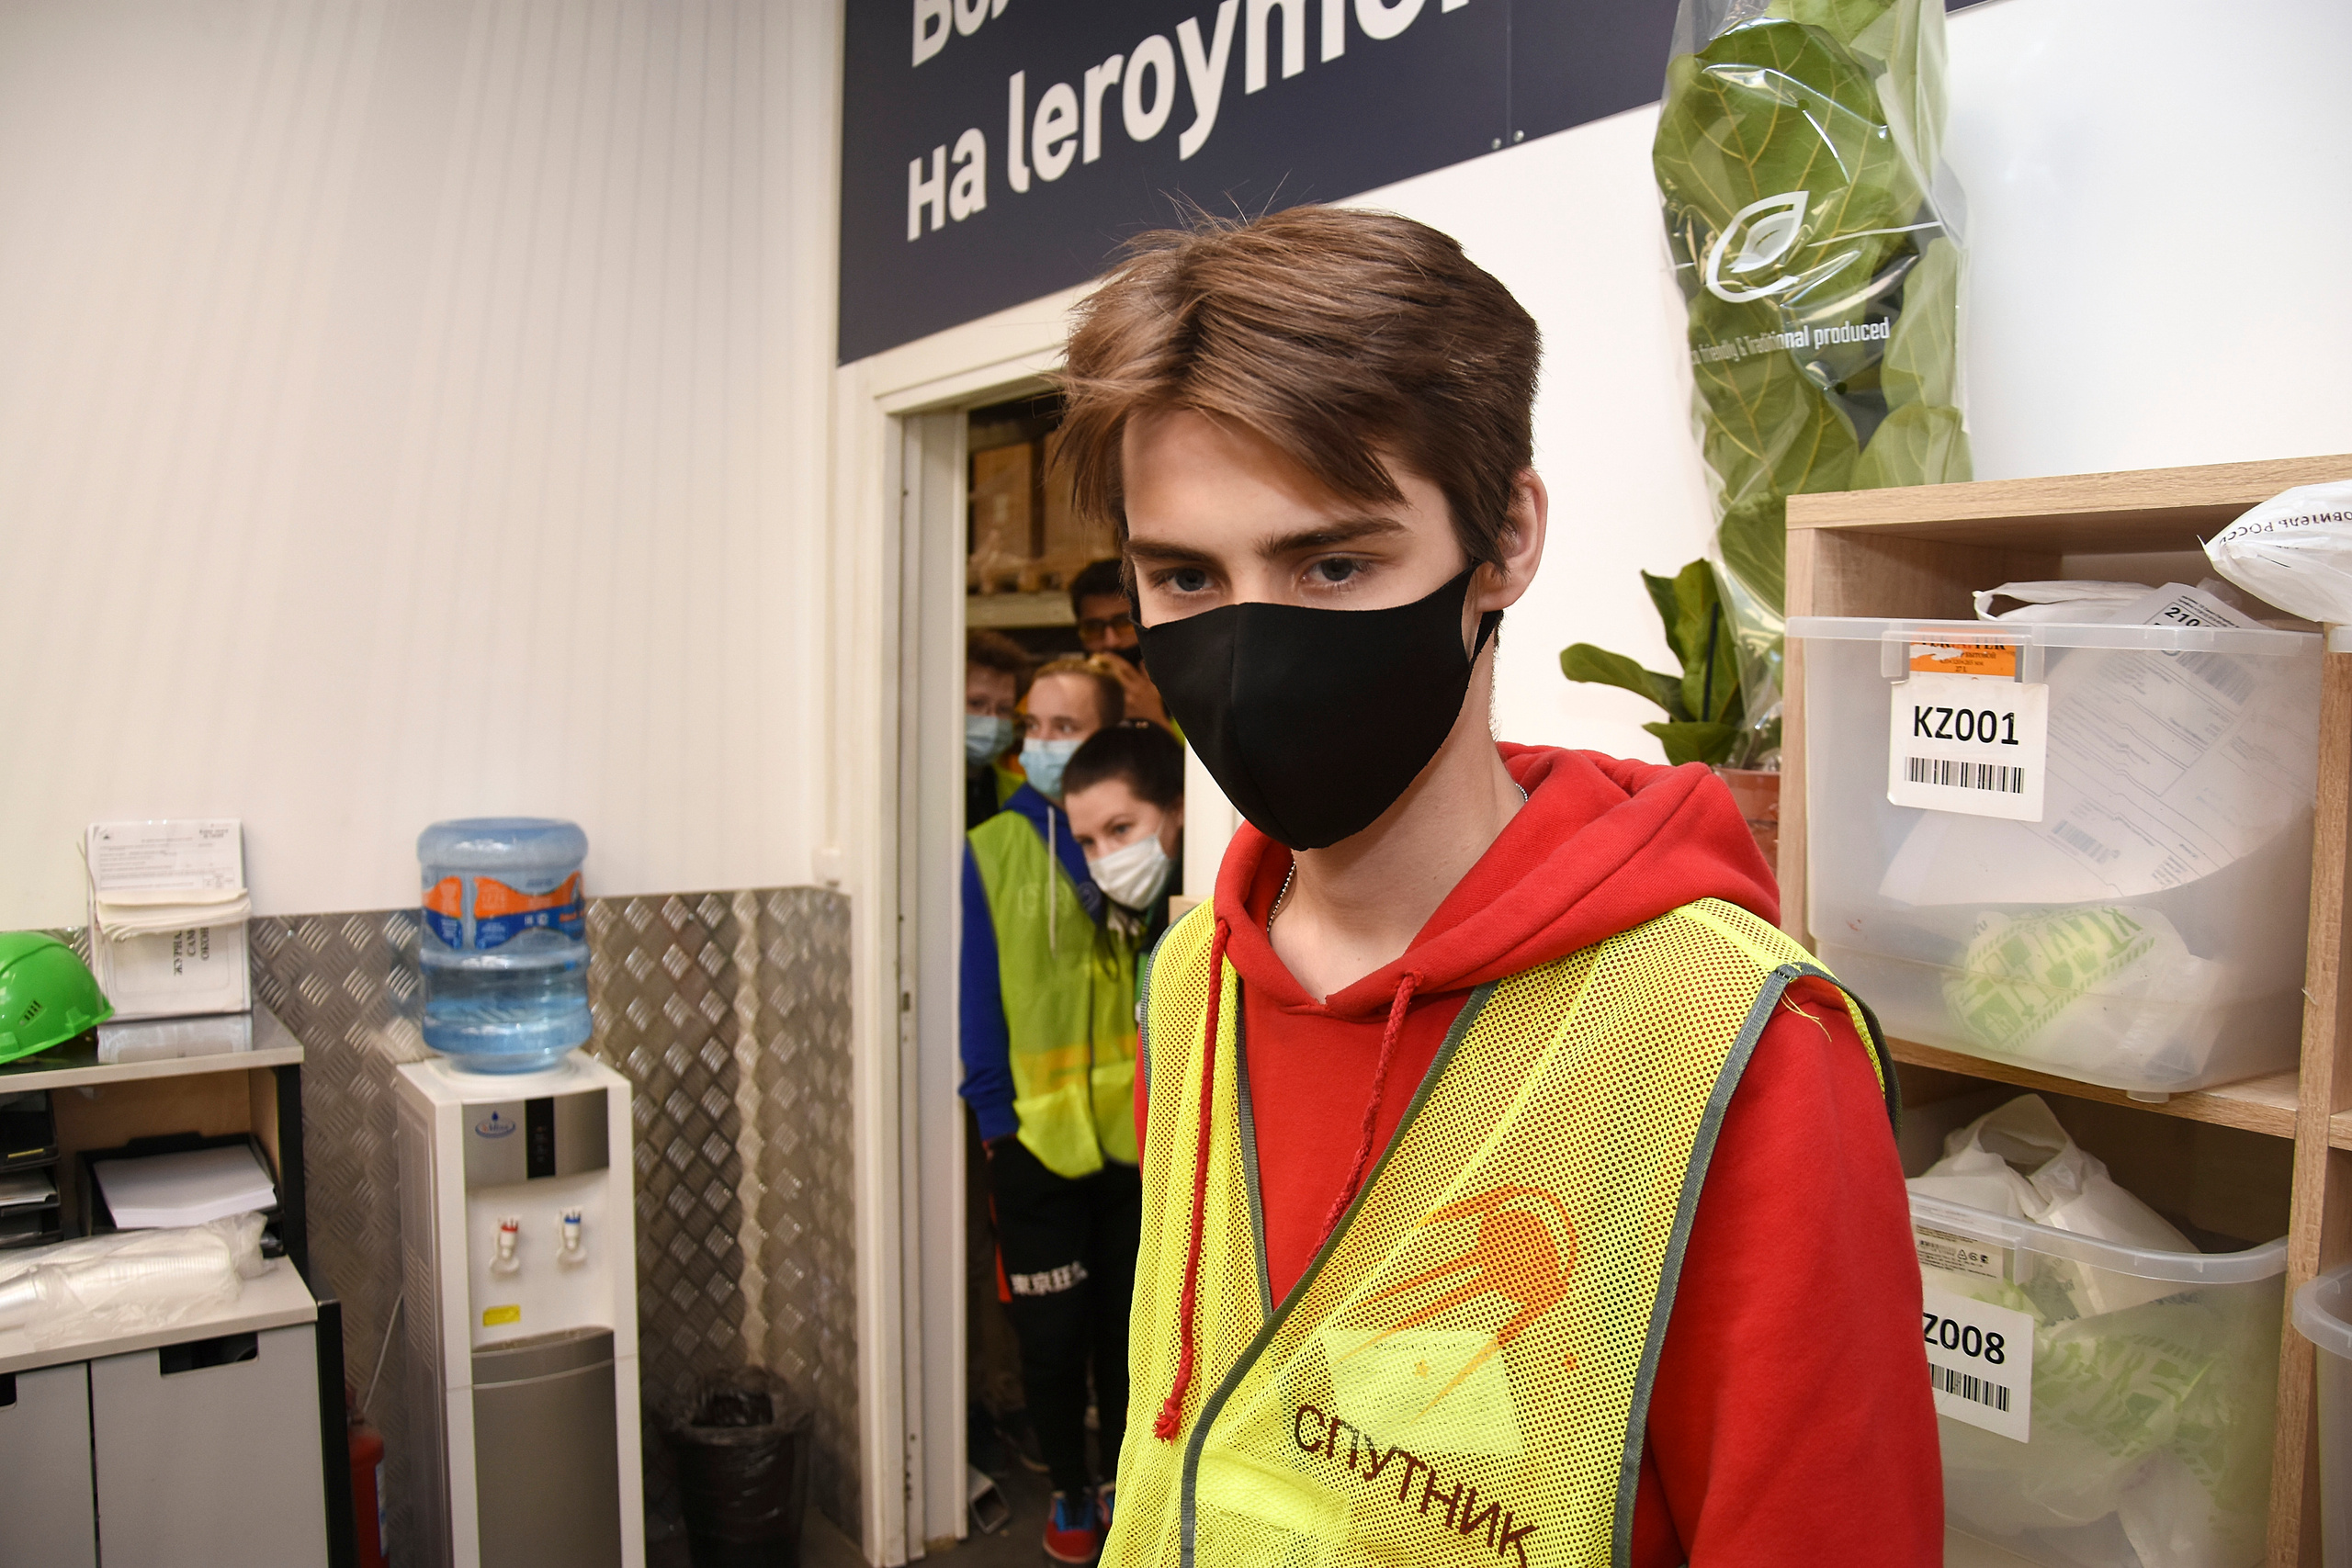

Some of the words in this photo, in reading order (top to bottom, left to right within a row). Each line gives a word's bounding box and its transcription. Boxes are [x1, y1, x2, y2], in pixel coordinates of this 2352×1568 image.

[907, 127, 986, 242] на
[1007, 0, 1470, 194] leroym
[1814, 316, 1891, 350] produced
[1914, 705, 2019, 745] KZ001
[174, 931, 183, 976] ЖУРНА
[1294, 1403, 1540, 1568] СПУТНИК
